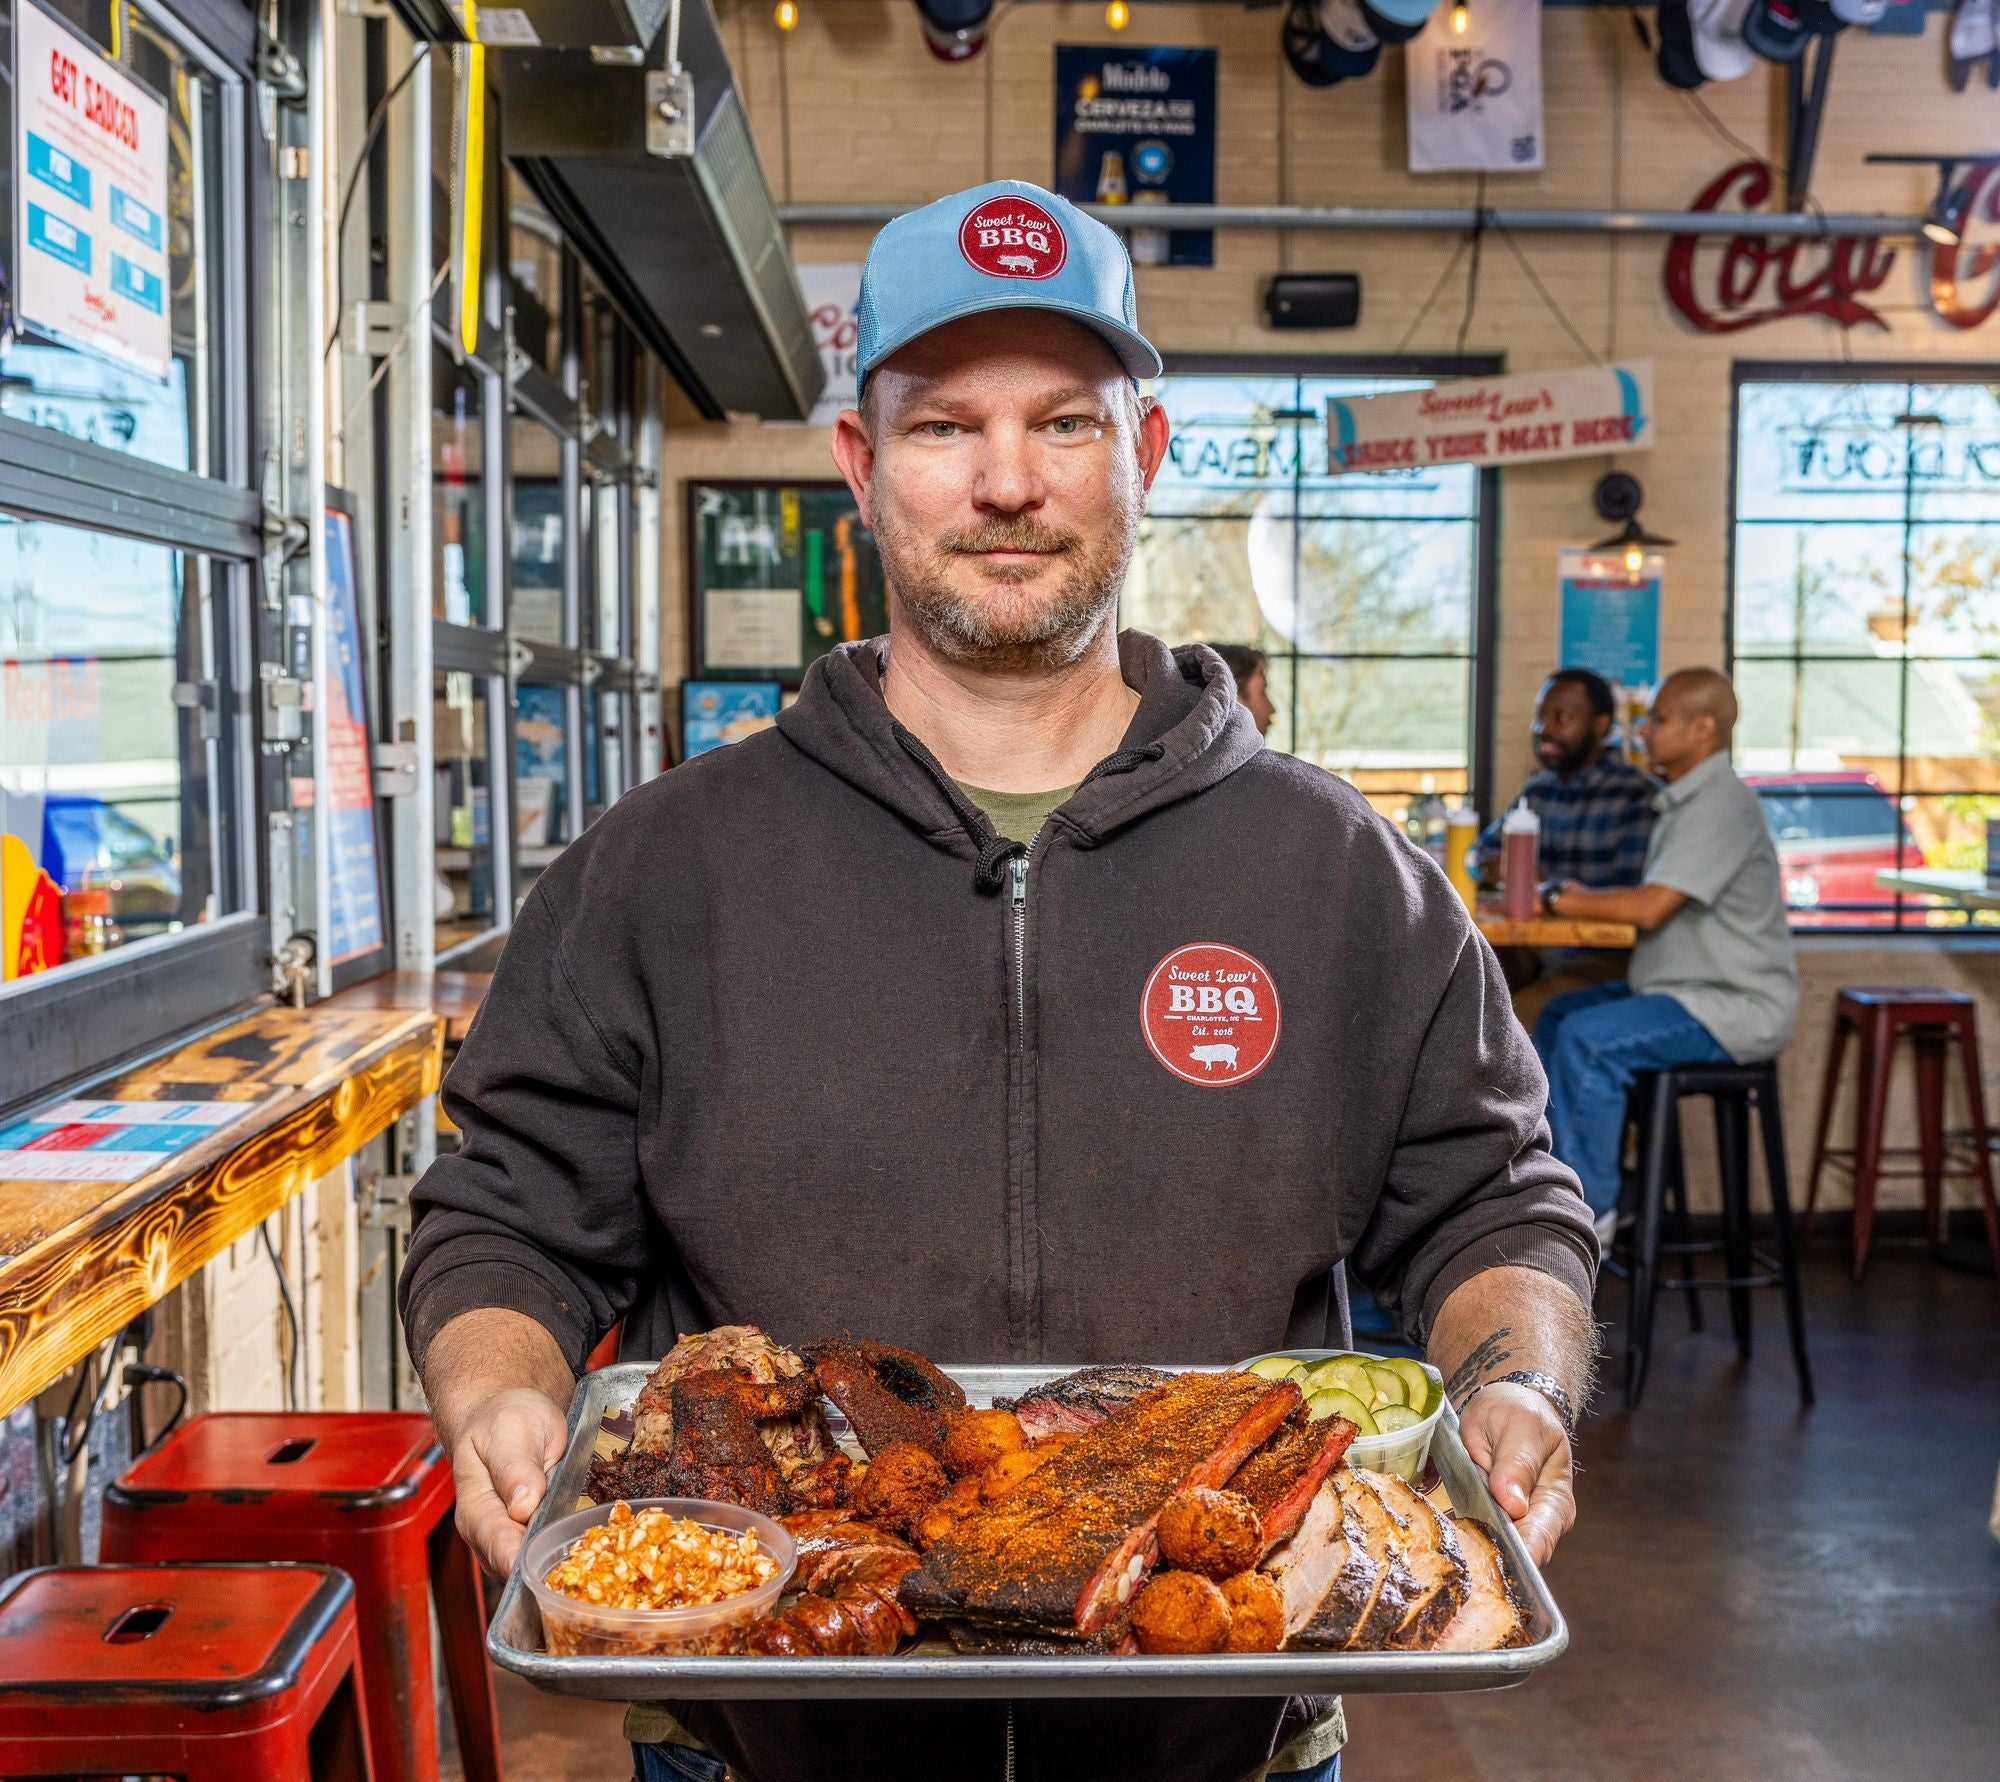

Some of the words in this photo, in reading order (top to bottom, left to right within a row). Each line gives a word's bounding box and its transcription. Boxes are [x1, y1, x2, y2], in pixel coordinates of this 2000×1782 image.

[51, 48, 78, 109] GET
[1103, 62, 1170, 92] Modelo
[1075, 99, 1166, 118] CERVEZA
[974, 214, 1013, 228] Sweet
[1017, 214, 1052, 233] Lew's
[978, 228, 1050, 253] BBQ
[1419, 388, 1485, 418] Sweet
[1486, 389, 1553, 423] Lew's
[1344, 437, 1416, 468] SAUCE
[1426, 430, 1488, 460] YOUR
[1497, 422, 1563, 454] MEAT
[1572, 415, 1634, 447] HERE
[4, 656, 51, 721] Red
[1168, 965, 1210, 982] Sweet
[1215, 968, 1258, 983] Lew's
[1169, 985, 1258, 1015] BBQ
[1192, 1025, 1209, 1036] Est.
[1213, 1028, 1233, 1036] 2018
